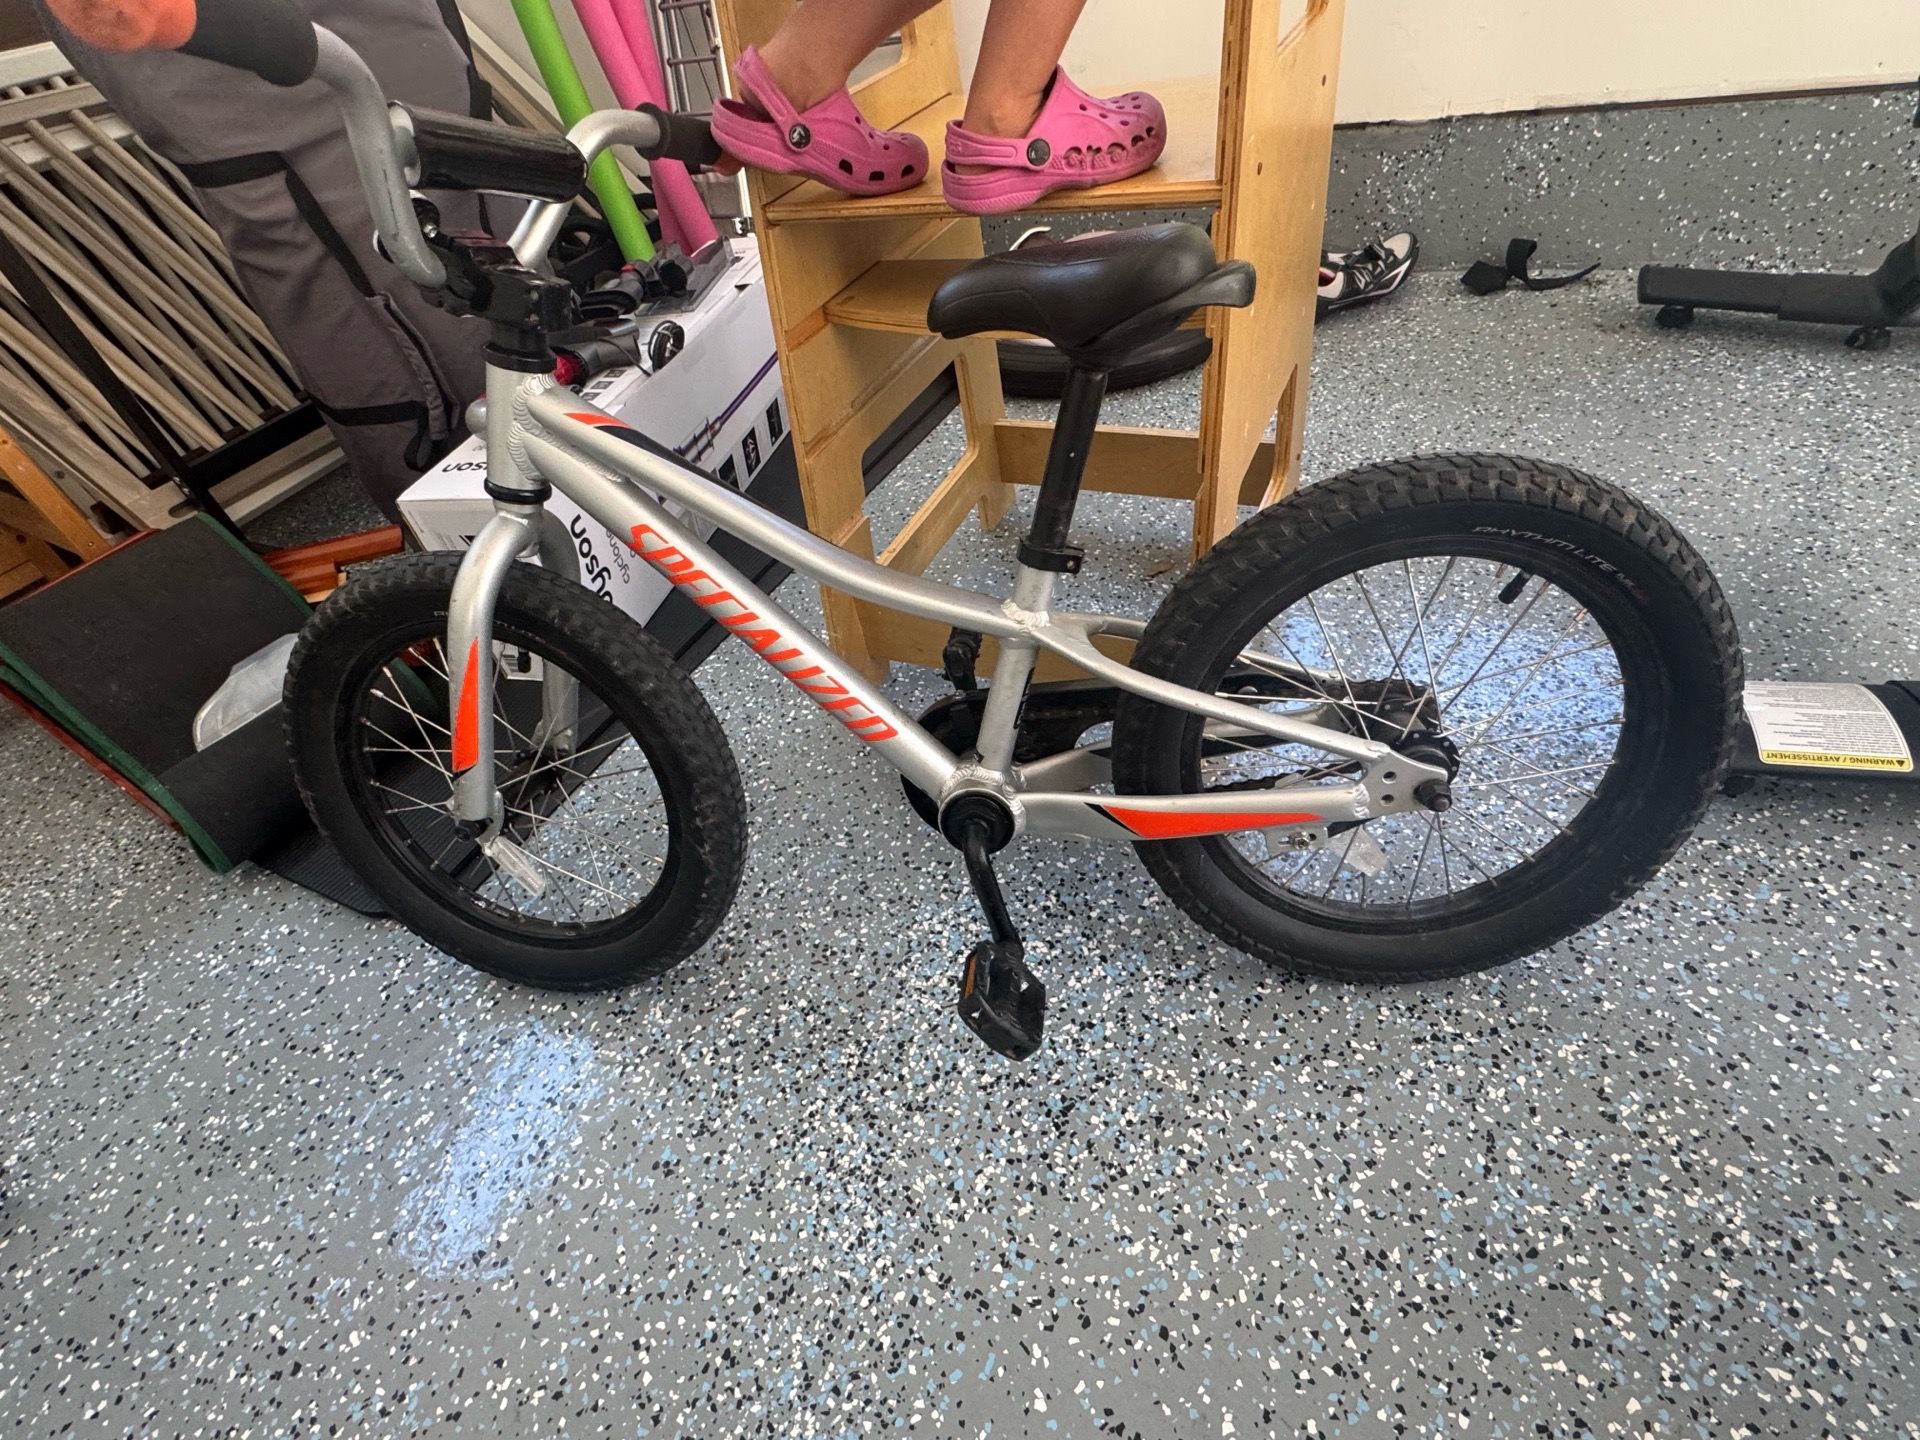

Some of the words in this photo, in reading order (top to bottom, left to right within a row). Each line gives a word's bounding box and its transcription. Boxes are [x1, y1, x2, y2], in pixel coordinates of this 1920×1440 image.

[1472, 526, 1576, 551] RHYTHM
[1573, 549, 1618, 572] LITE
[629, 523, 898, 742] SPECIALIZED
[1766, 752, 1842, 762] AVERTISSEMENT
[1850, 757, 1895, 766] WARNING
